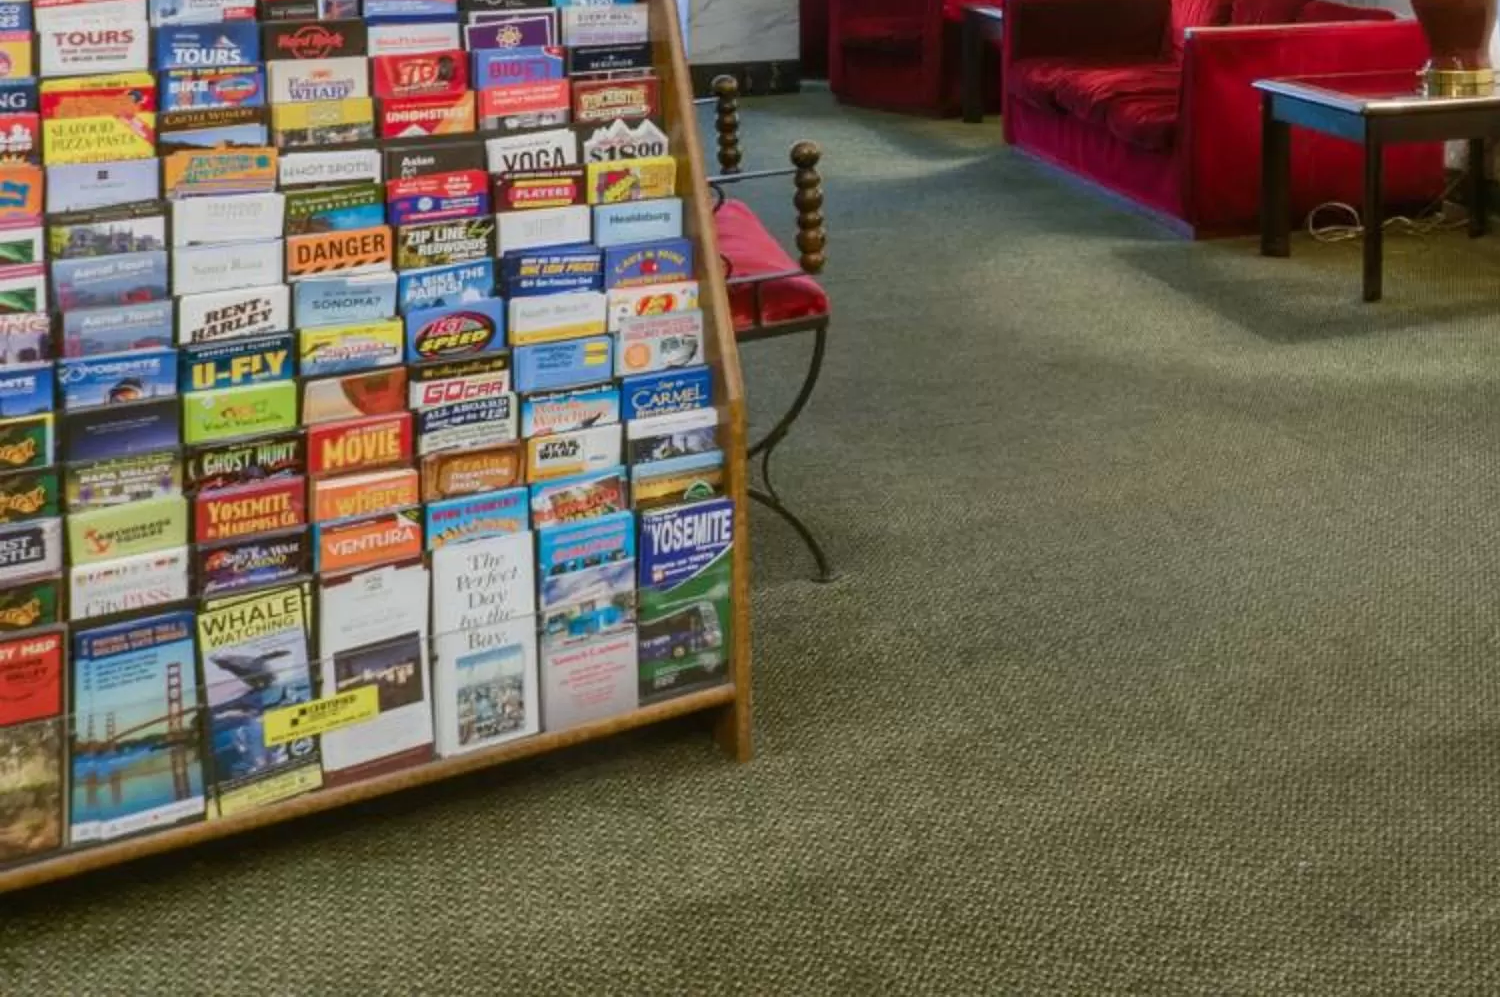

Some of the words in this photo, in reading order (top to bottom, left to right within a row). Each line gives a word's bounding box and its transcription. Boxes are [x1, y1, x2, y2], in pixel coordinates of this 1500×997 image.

[53, 29, 135, 46] TOURS
[173, 48, 241, 64] TOURS
[289, 87, 350, 101] WHARF
[502, 146, 566, 172] YOGA
[514, 186, 571, 200] PLAYERS
[296, 233, 386, 265] DANGER
[407, 230, 431, 247] ZIP
[433, 226, 466, 244] LINE
[205, 298, 262, 323] RENT
[190, 308, 273, 344] HARLEY
[419, 330, 490, 353] SPEED
[192, 349, 288, 389] U-FLY
[632, 383, 707, 410] CARMEL
[203, 445, 252, 477] GHOST
[257, 440, 298, 467] HUNT
[322, 426, 401, 470] MOVIE
[543, 439, 581, 452] STAR
[206, 491, 292, 524] YOSEMITE
[336, 485, 411, 516] where
[328, 527, 415, 557] VENTURA
[651, 507, 733, 555] YOSEMITE
[466, 552, 504, 571] The
[456, 566, 518, 591] Perfect
[467, 589, 508, 609] Day
[202, 594, 299, 636] WHALE
[209, 615, 295, 648] WATCHING
